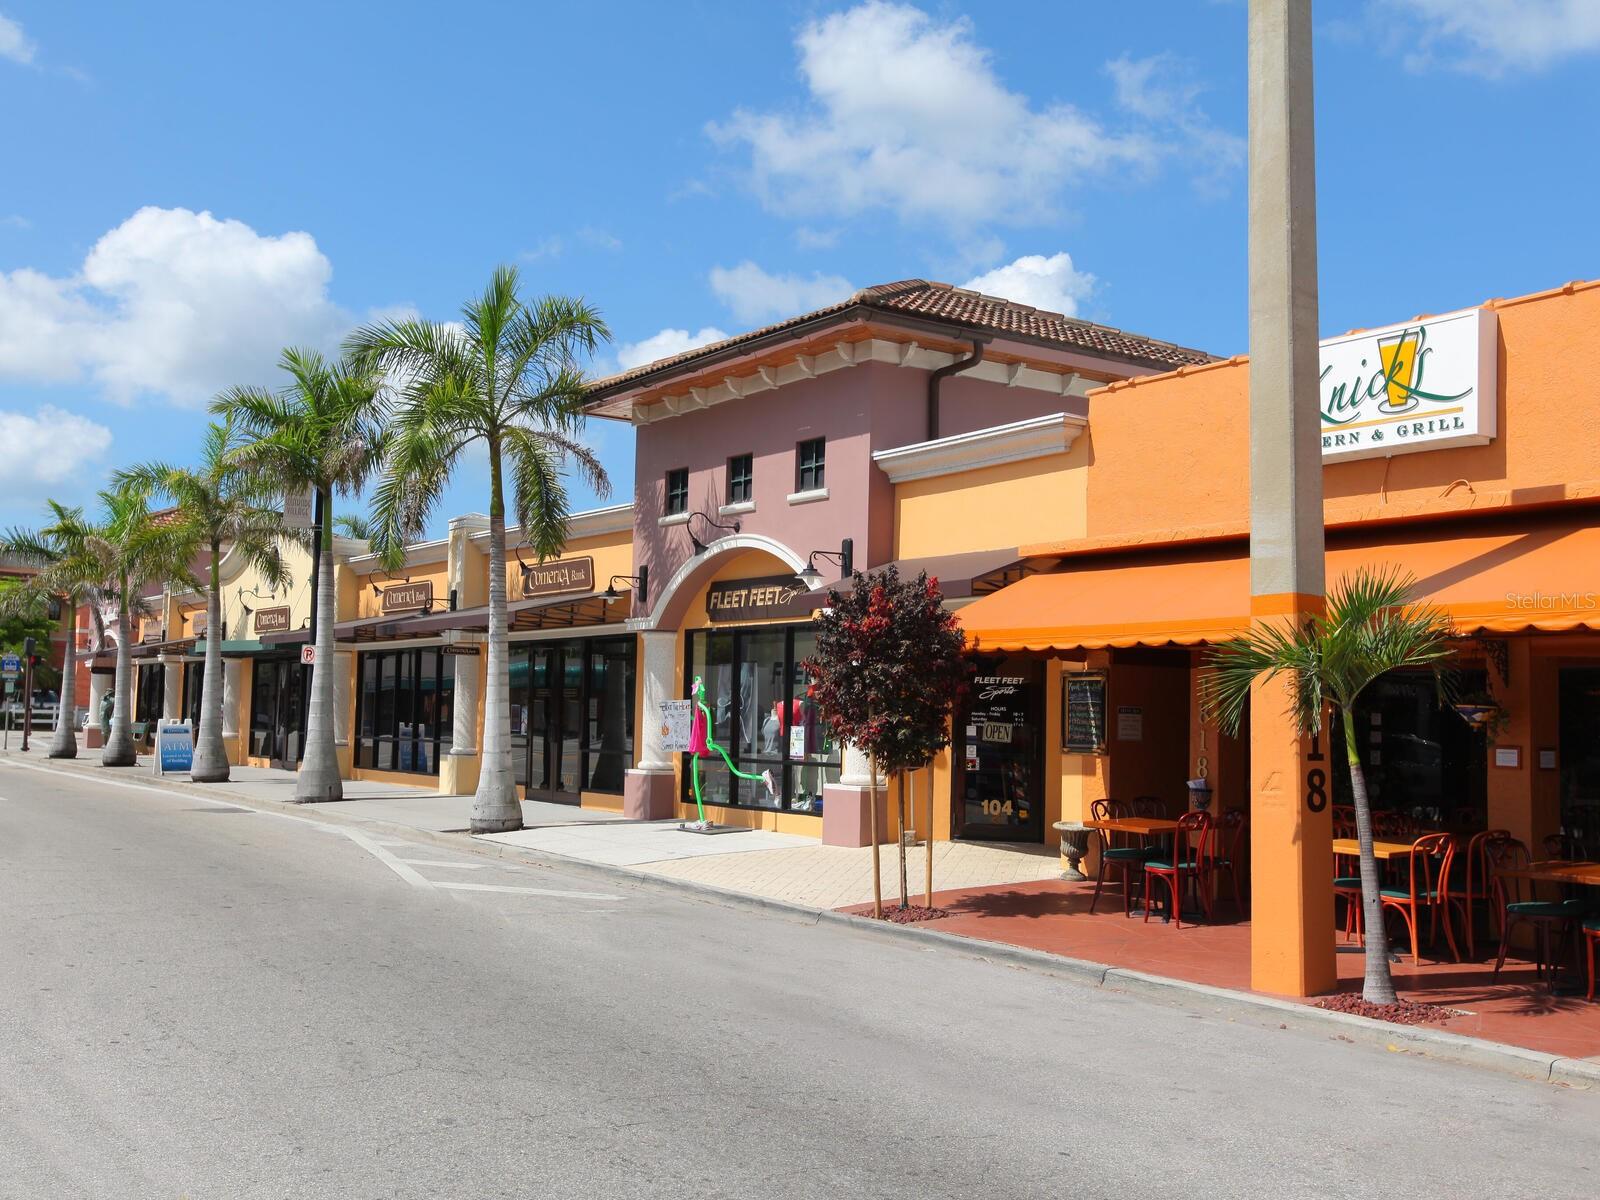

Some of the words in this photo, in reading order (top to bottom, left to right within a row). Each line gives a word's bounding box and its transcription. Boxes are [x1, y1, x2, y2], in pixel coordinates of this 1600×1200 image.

[1320, 325, 1473, 424] nick's
[1322, 431, 1361, 448] ERN
[1371, 428, 1384, 442] &
[1396, 416, 1465, 437] GRILL
[571, 568, 585, 581] Bank
[710, 589, 748, 609] FLEET
[749, 586, 782, 607] FEET
[974, 676, 1001, 684] FLEET
[979, 685, 1020, 700] Sports
[985, 723, 1010, 741] OPEN
[165, 743, 189, 751] ATM
[981, 799, 1014, 816] 104
